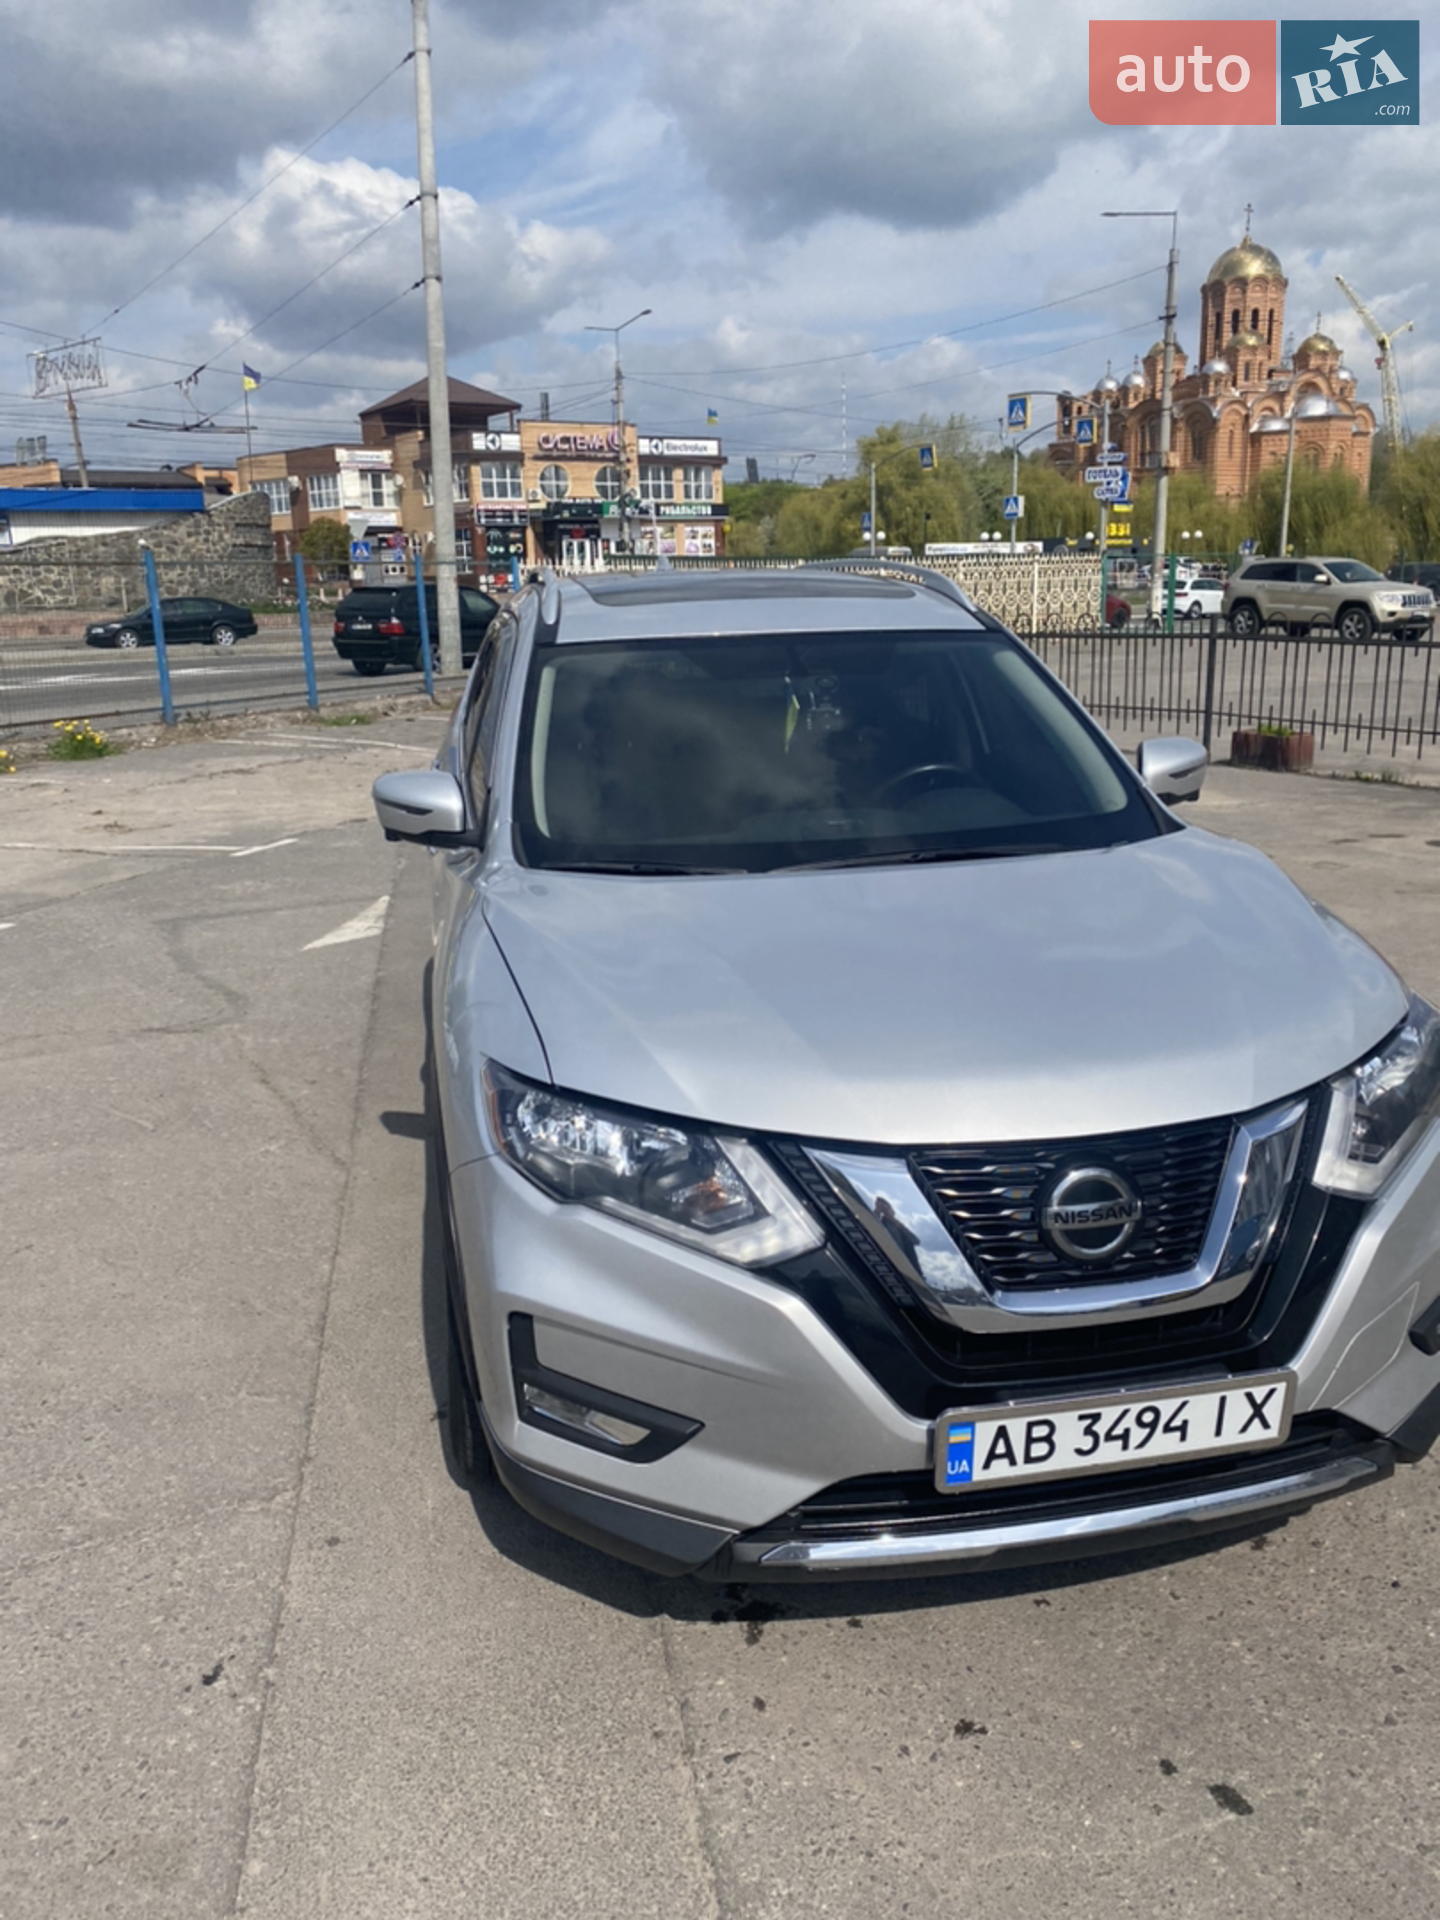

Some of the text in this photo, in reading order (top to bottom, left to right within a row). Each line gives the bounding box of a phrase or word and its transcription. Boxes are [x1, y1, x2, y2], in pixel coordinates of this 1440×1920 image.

[665, 441, 708, 453] Electrolux
[1053, 1205, 1132, 1225] NISSAN
[982, 1418, 1057, 1471] AB
[1073, 1400, 1190, 1457] 3494
[947, 1460, 970, 1475] UA
